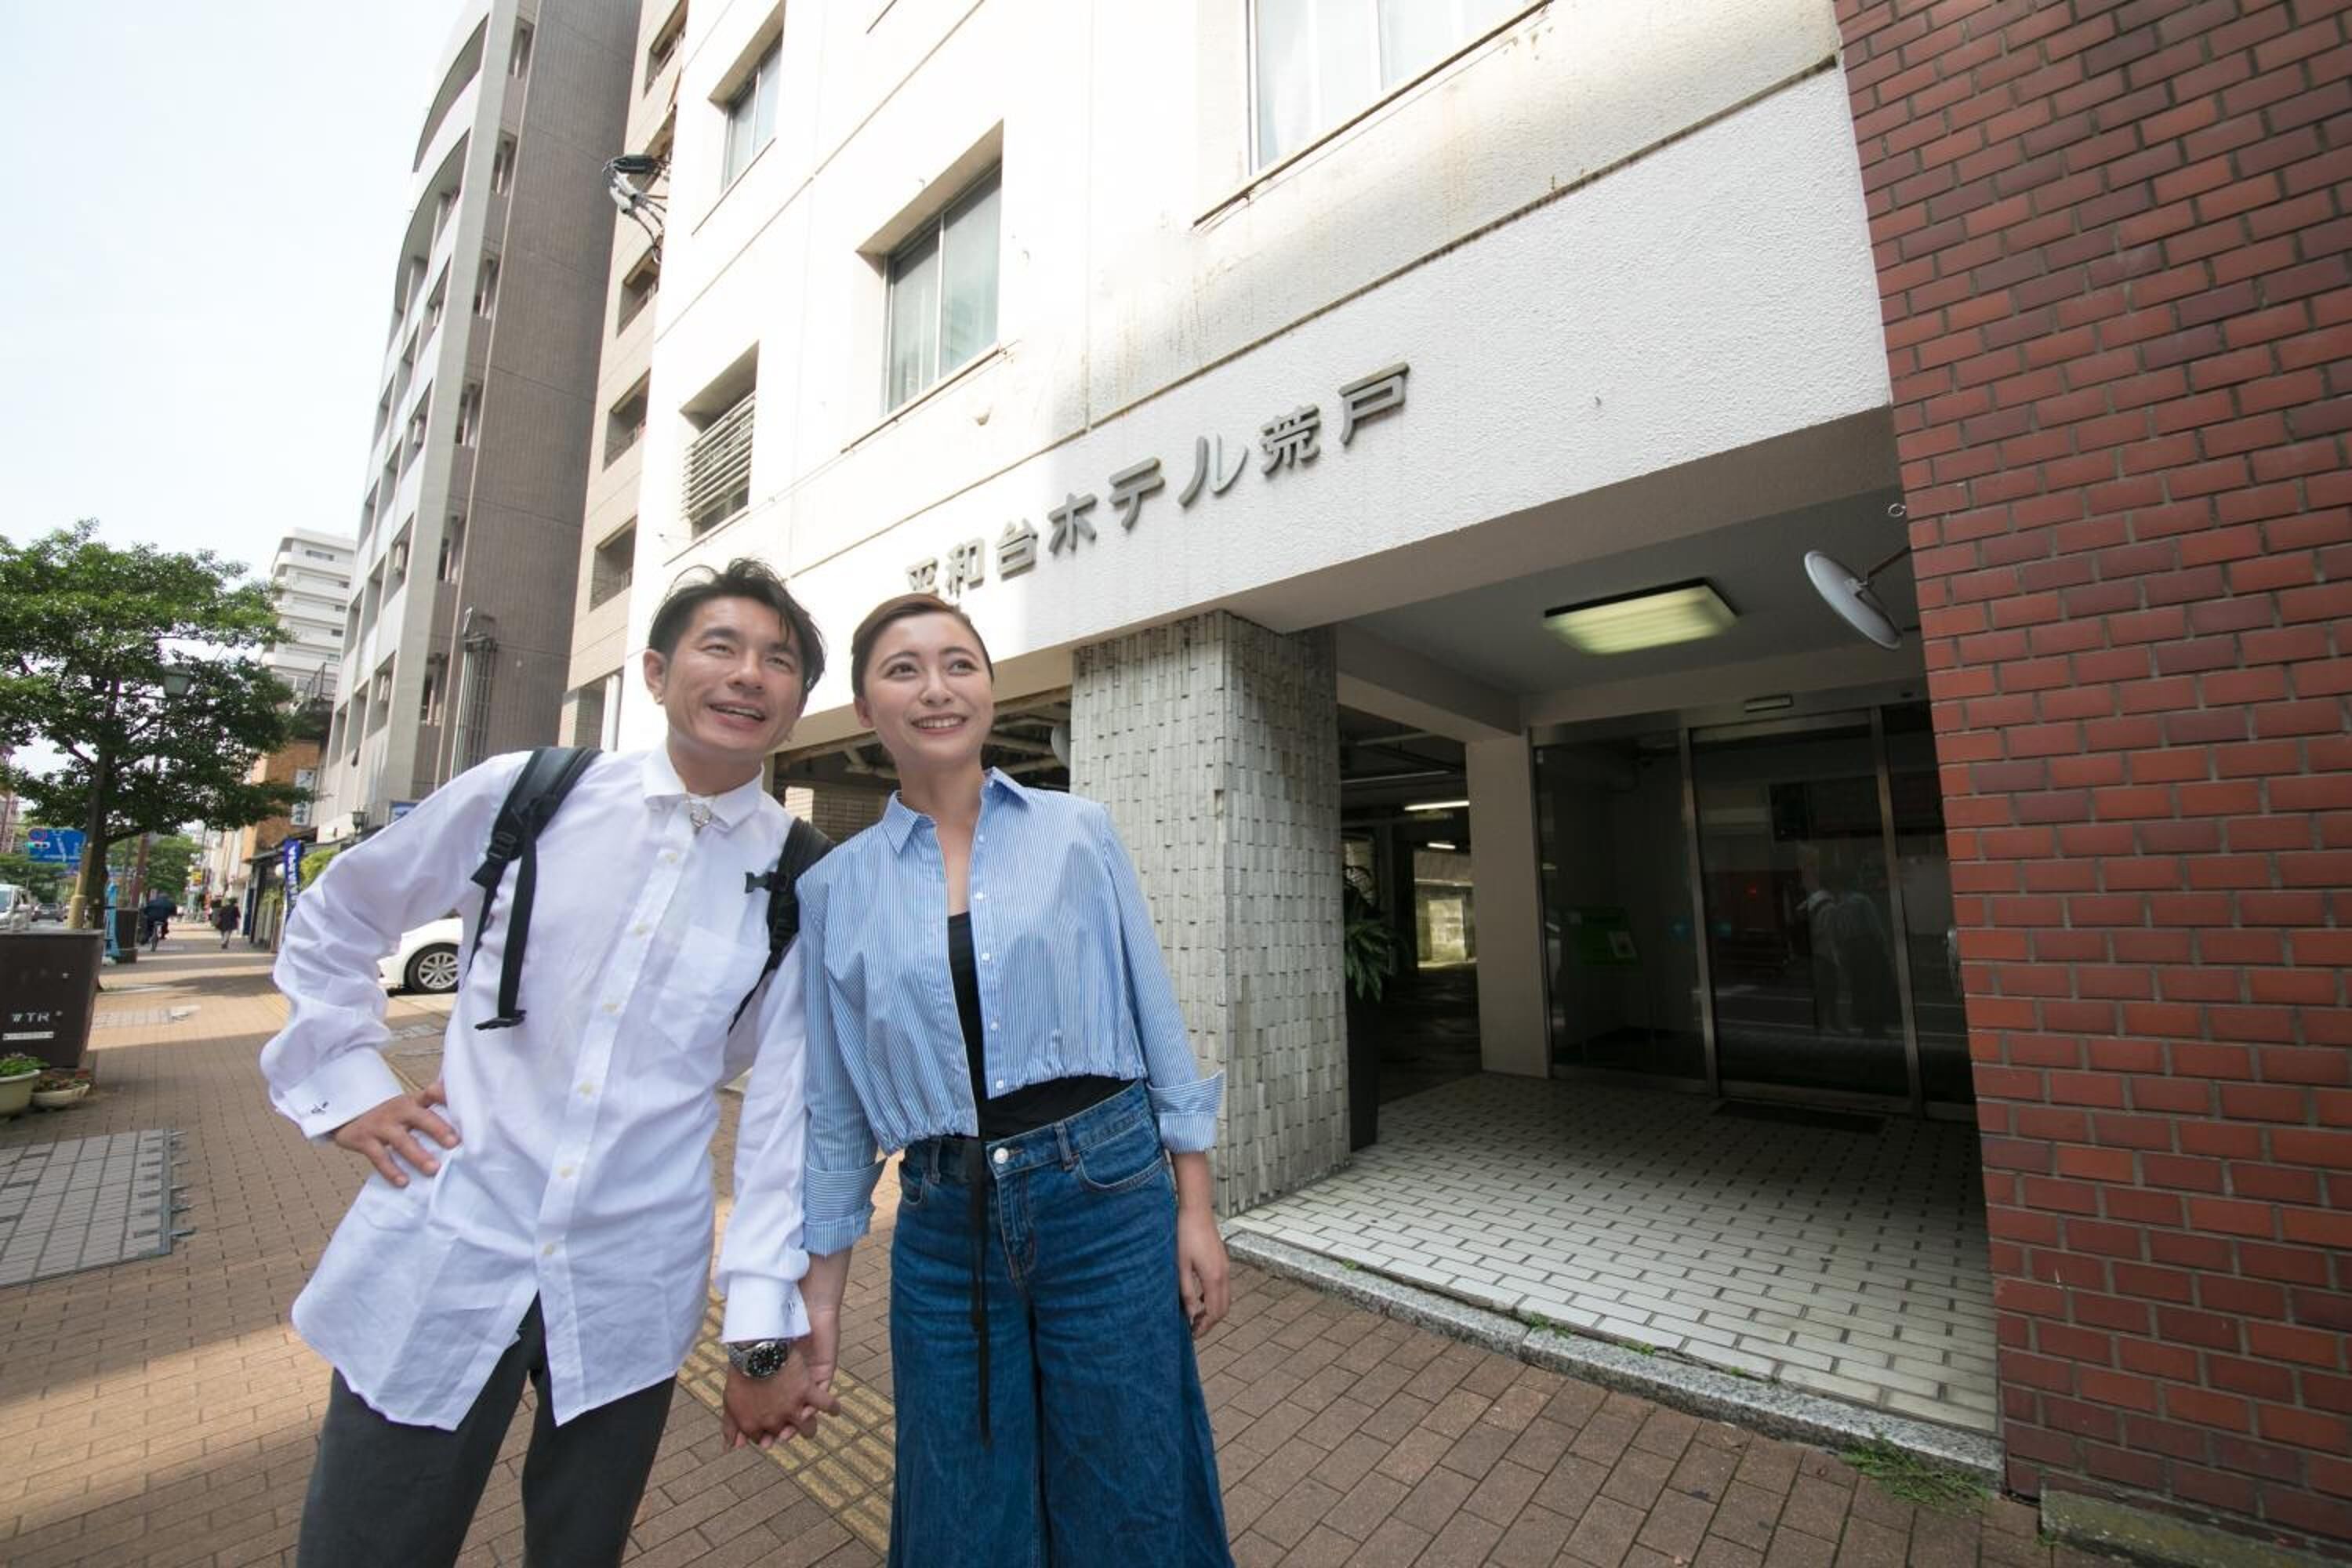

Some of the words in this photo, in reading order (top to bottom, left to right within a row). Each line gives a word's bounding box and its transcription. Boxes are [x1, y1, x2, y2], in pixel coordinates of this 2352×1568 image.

[906, 361, 1410, 598] 平和台ホテル荒戸
